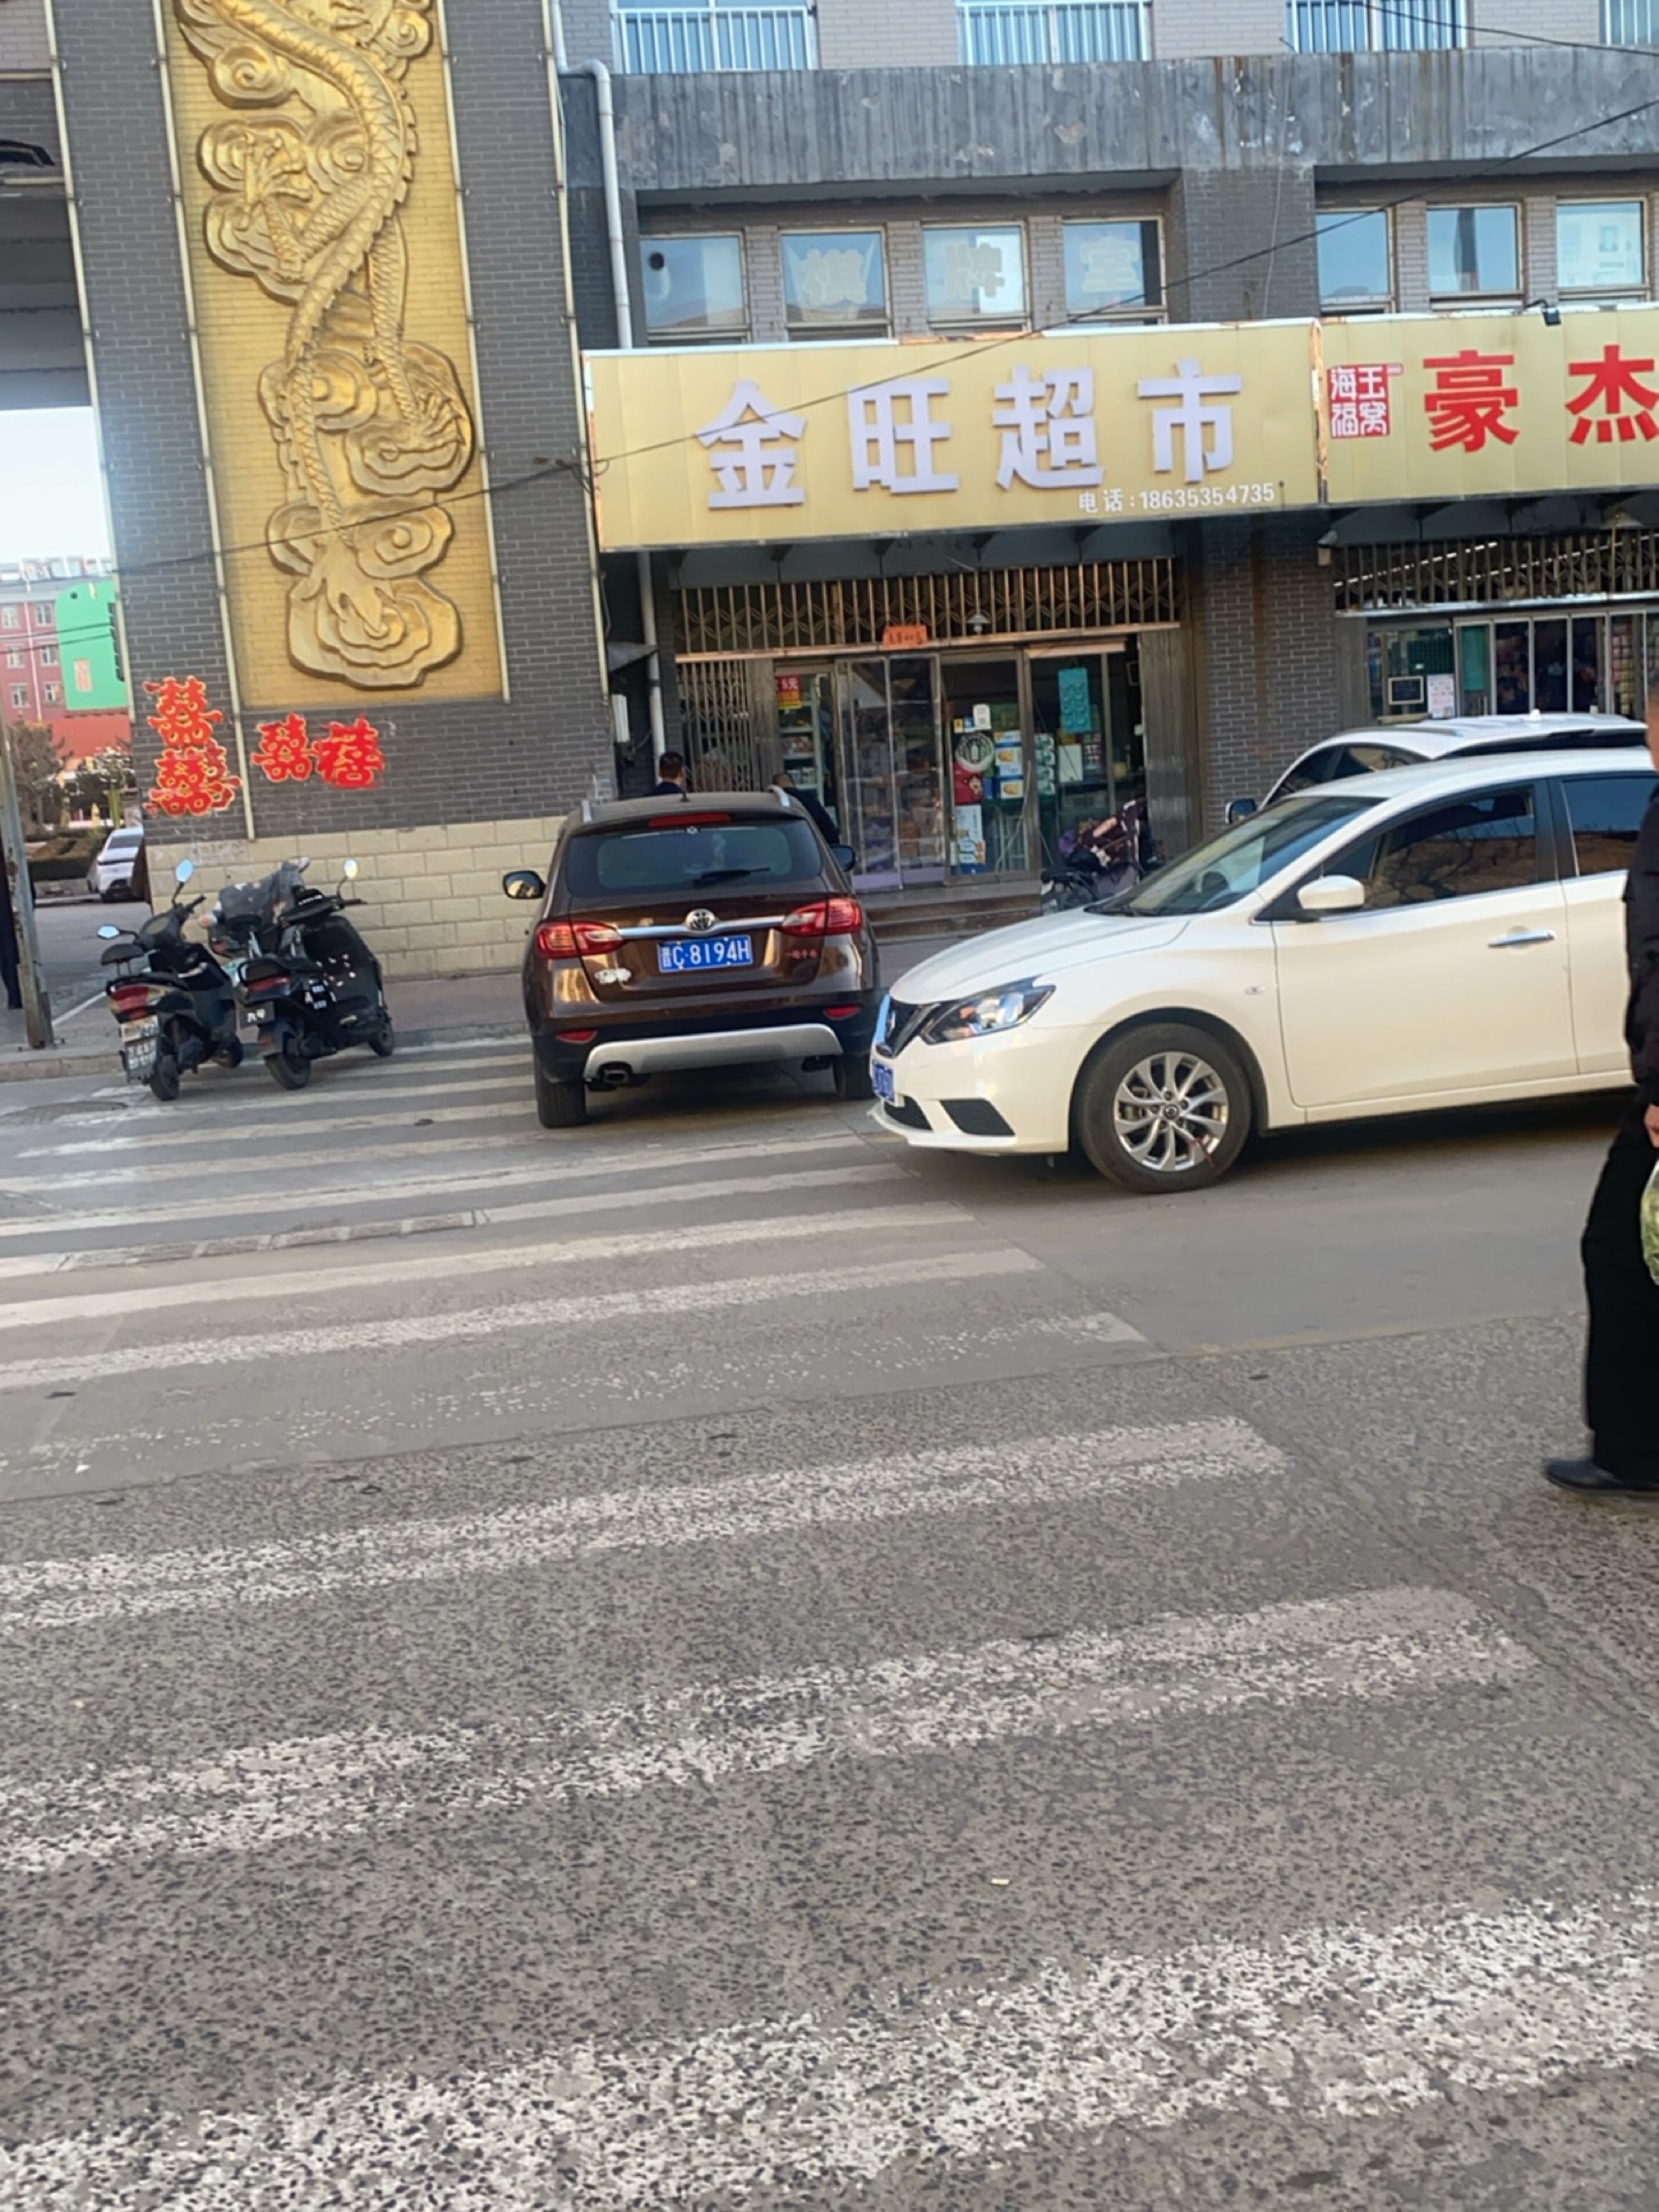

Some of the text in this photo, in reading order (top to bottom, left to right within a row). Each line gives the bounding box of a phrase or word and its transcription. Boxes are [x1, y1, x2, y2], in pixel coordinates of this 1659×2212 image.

[695, 357, 1242, 510] 金旺超市
[1423, 344, 1659, 453] 豪杰
